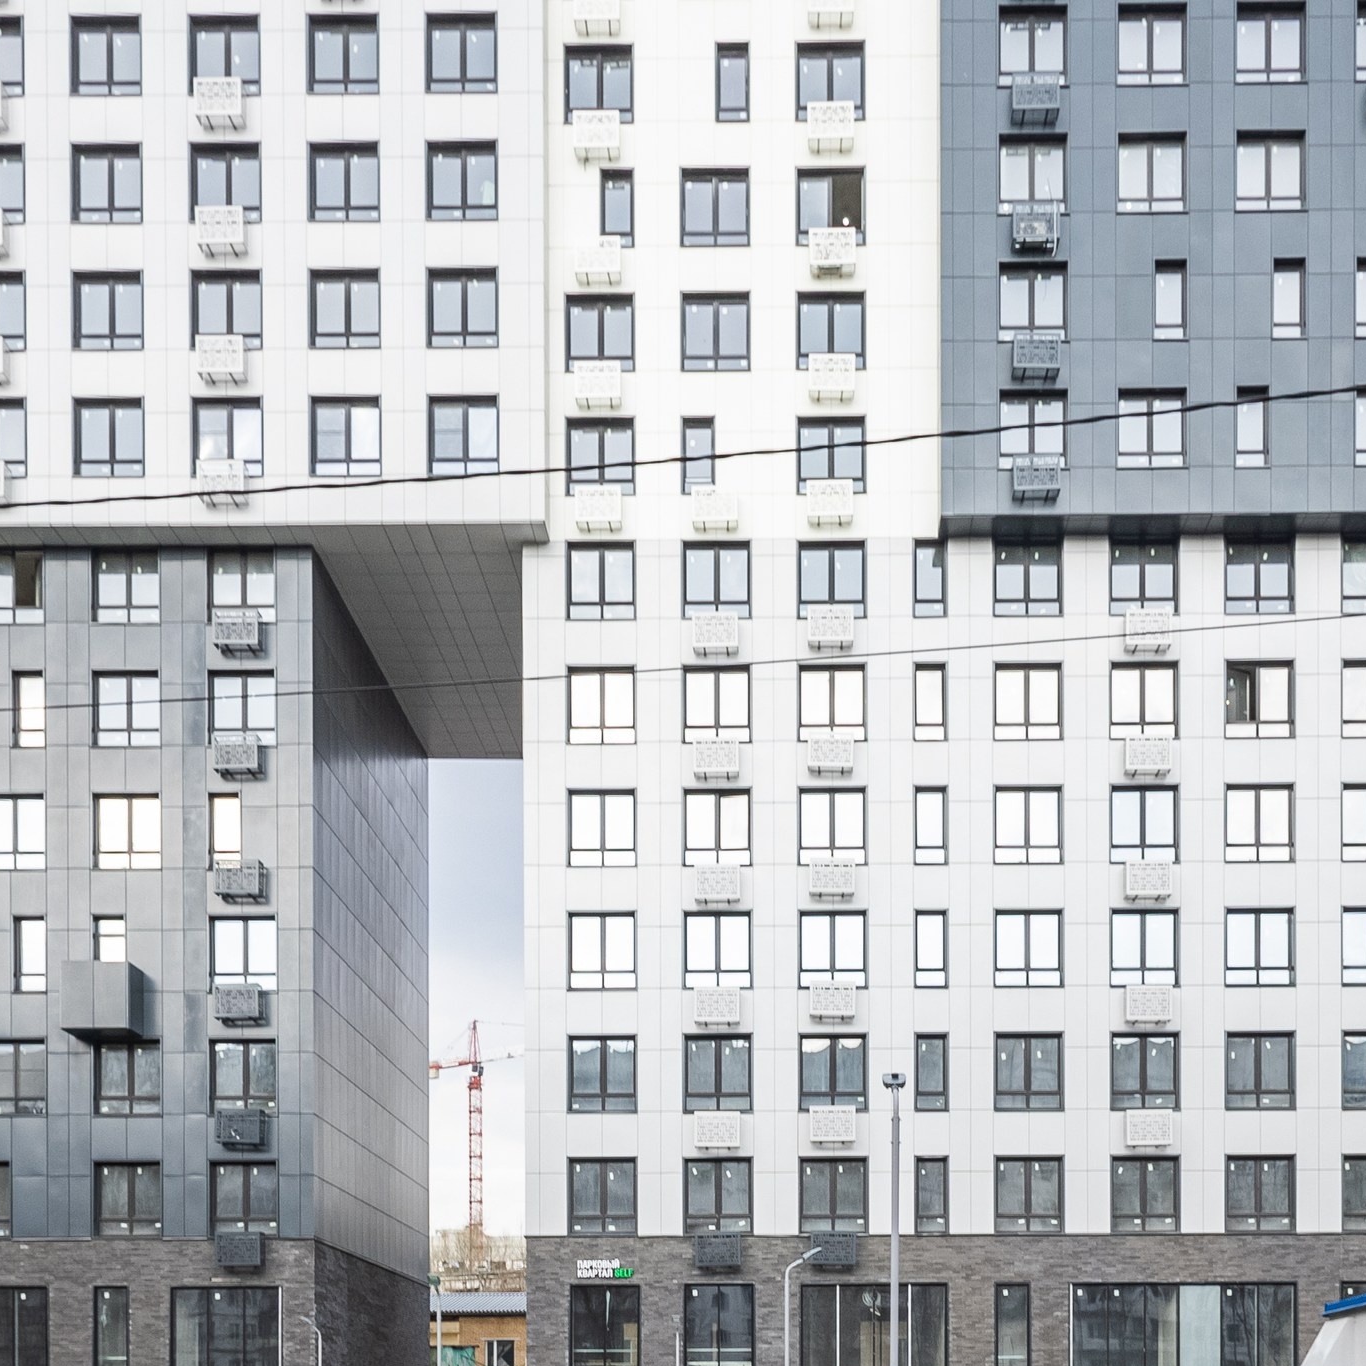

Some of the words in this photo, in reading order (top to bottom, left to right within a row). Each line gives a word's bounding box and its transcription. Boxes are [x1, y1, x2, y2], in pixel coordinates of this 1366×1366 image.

[576, 1258, 620, 1269] ПАРКОВЫЙ
[577, 1268, 614, 1278] КВАРТАЛ
[614, 1268, 634, 1278] SELF
